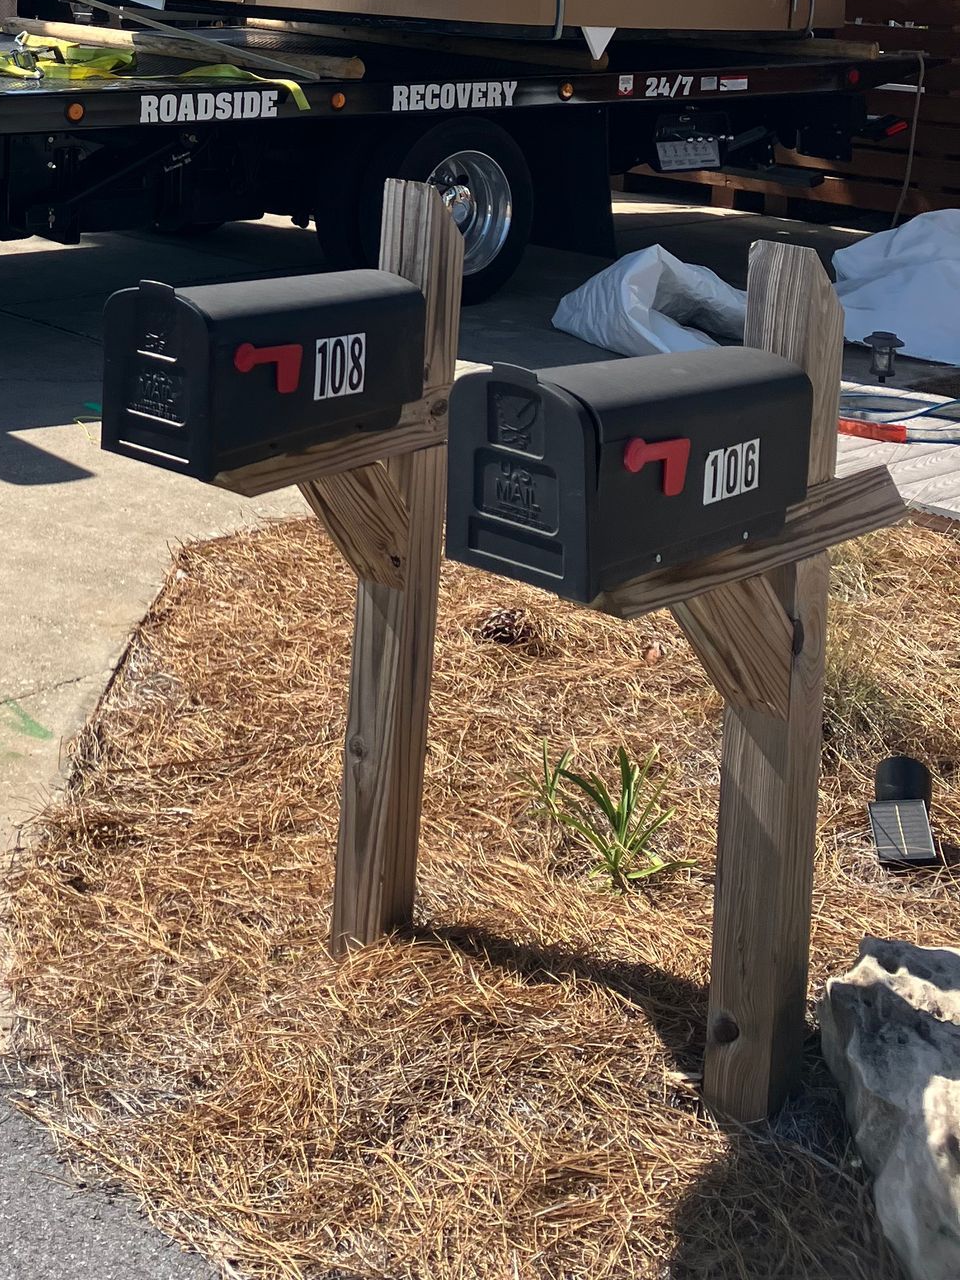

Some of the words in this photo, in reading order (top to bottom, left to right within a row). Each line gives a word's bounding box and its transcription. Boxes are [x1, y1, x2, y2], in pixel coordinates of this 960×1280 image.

[392, 81, 518, 112] RECOVERY
[645, 74, 694, 99] 24/7
[140, 90, 279, 123] ROADSIDE
[317, 335, 363, 397] 108
[710, 443, 756, 499] 106
[495, 478, 541, 511] MAIL
